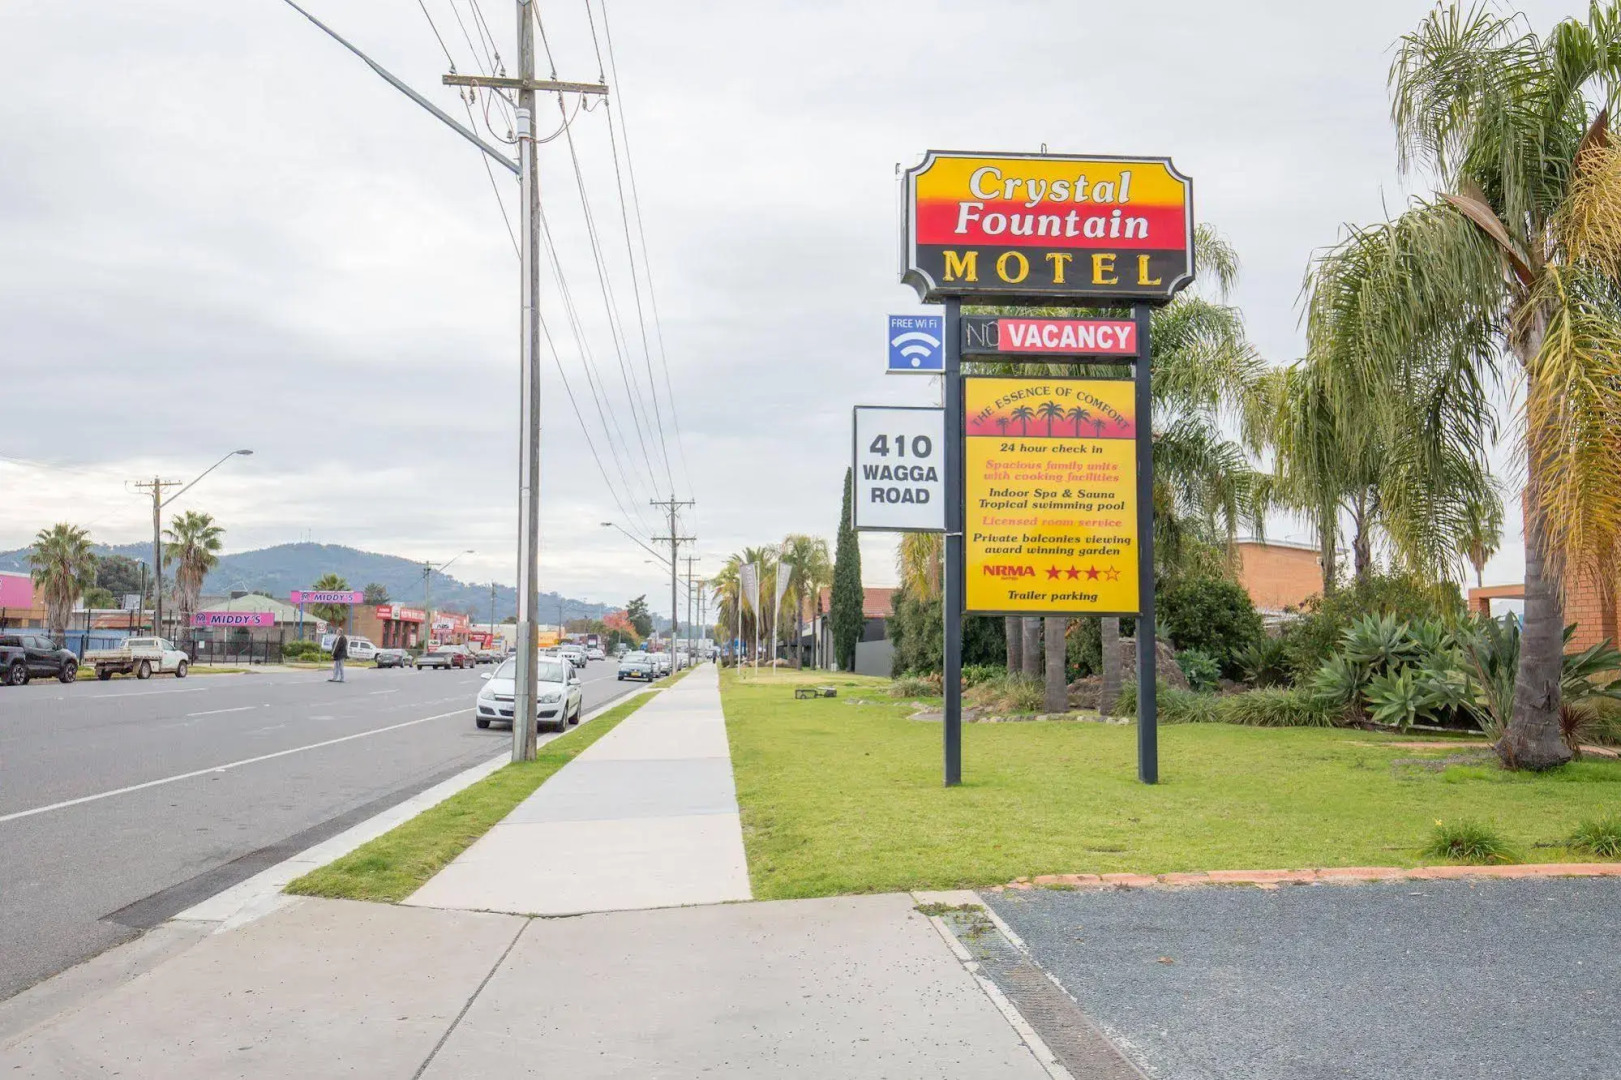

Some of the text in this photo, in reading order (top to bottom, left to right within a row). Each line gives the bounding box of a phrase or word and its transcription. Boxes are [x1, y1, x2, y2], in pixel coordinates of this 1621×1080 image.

[969, 166, 1132, 208] Crystal
[954, 201, 1148, 239] Fountain
[943, 250, 1162, 285] MOTEL
[891, 318, 937, 328] FREE Wi Fi
[966, 321, 1131, 349] NO VACANCY
[972, 386, 1131, 430] THE ESSENCE OF COMFORT
[869, 434, 932, 458] 410
[1000, 443, 1103, 454] 24 hour check in
[986, 459, 1118, 472] Spacious family units
[863, 464, 938, 482] WAGGA
[984, 471, 1119, 482] with cooking facilities
[871, 487, 930, 504] ROAD
[989, 488, 1115, 499] Indoor Spa & Sauna
[979, 499, 1125, 511] Tropical swimming pool
[982, 516, 1037, 526] Licensed
[1079, 518, 1122, 527] service
[973, 533, 1131, 545] Private balconies viewing
[985, 545, 1120, 556] award winning garden
[983, 565, 1036, 577] NRMA
[1008, 590, 1098, 602] Trailer parking
[211, 615, 261, 624] MIDDY'S
